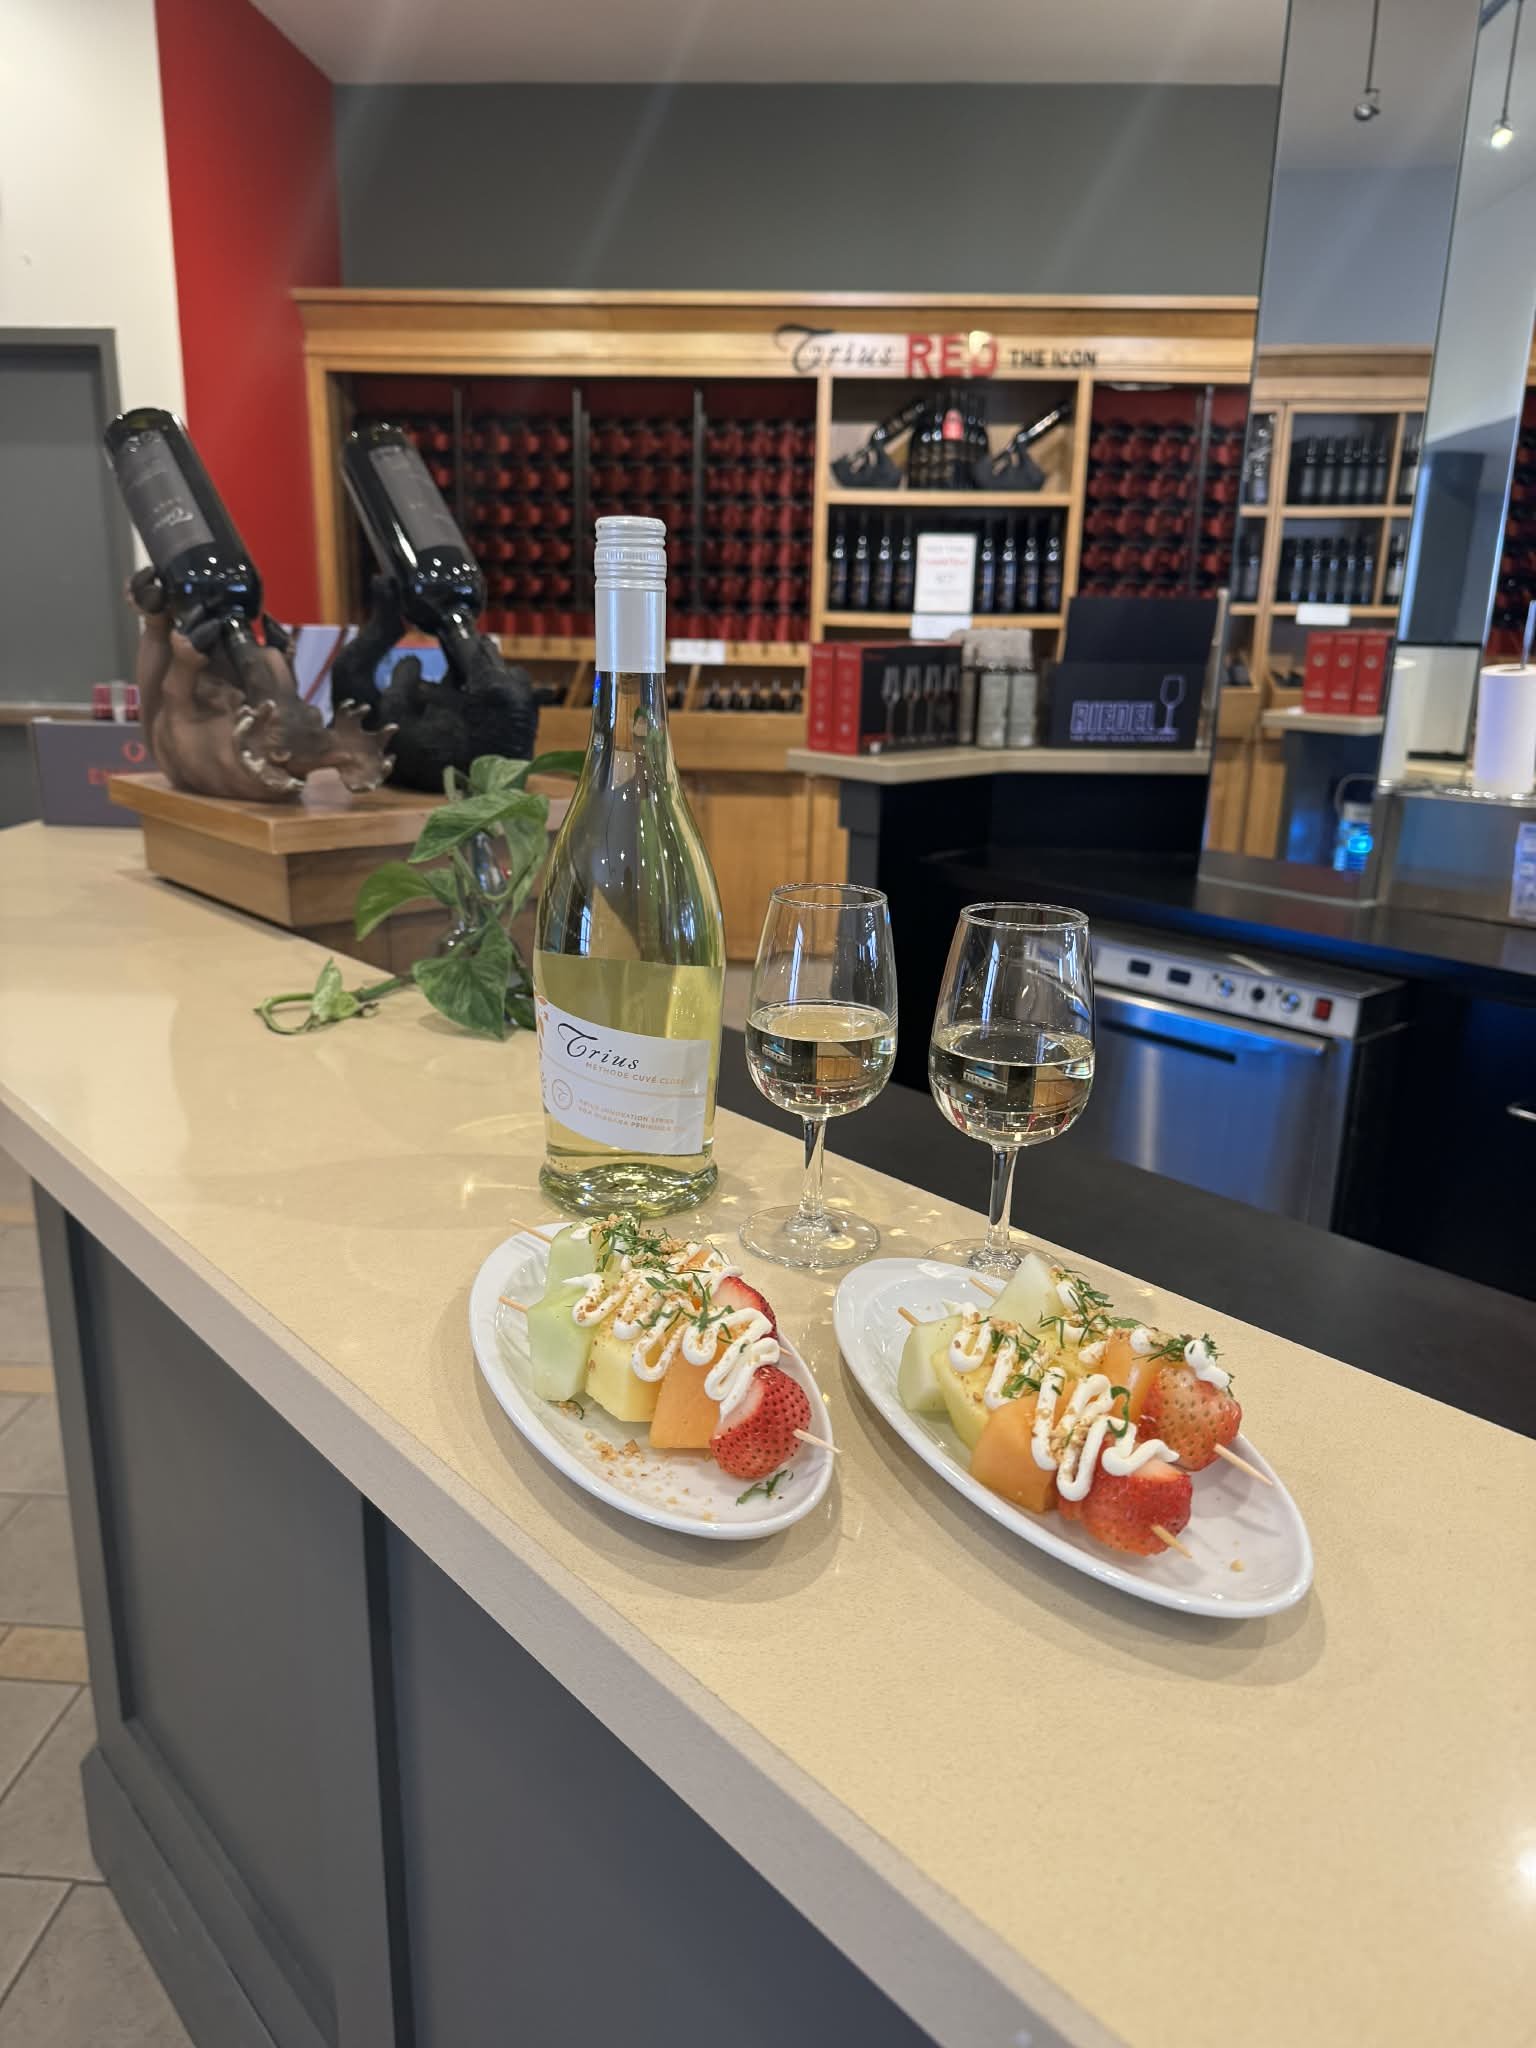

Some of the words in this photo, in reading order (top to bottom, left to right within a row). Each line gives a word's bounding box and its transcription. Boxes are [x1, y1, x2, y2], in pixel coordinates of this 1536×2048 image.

[773, 323, 893, 376] Trius
[904, 333, 1000, 378] RED
[1009, 349, 1045, 368] THE
[1052, 349, 1098, 369] ICON
[1069, 700, 1156, 735] RIEDEL
[557, 1022, 640, 1071] Trius
